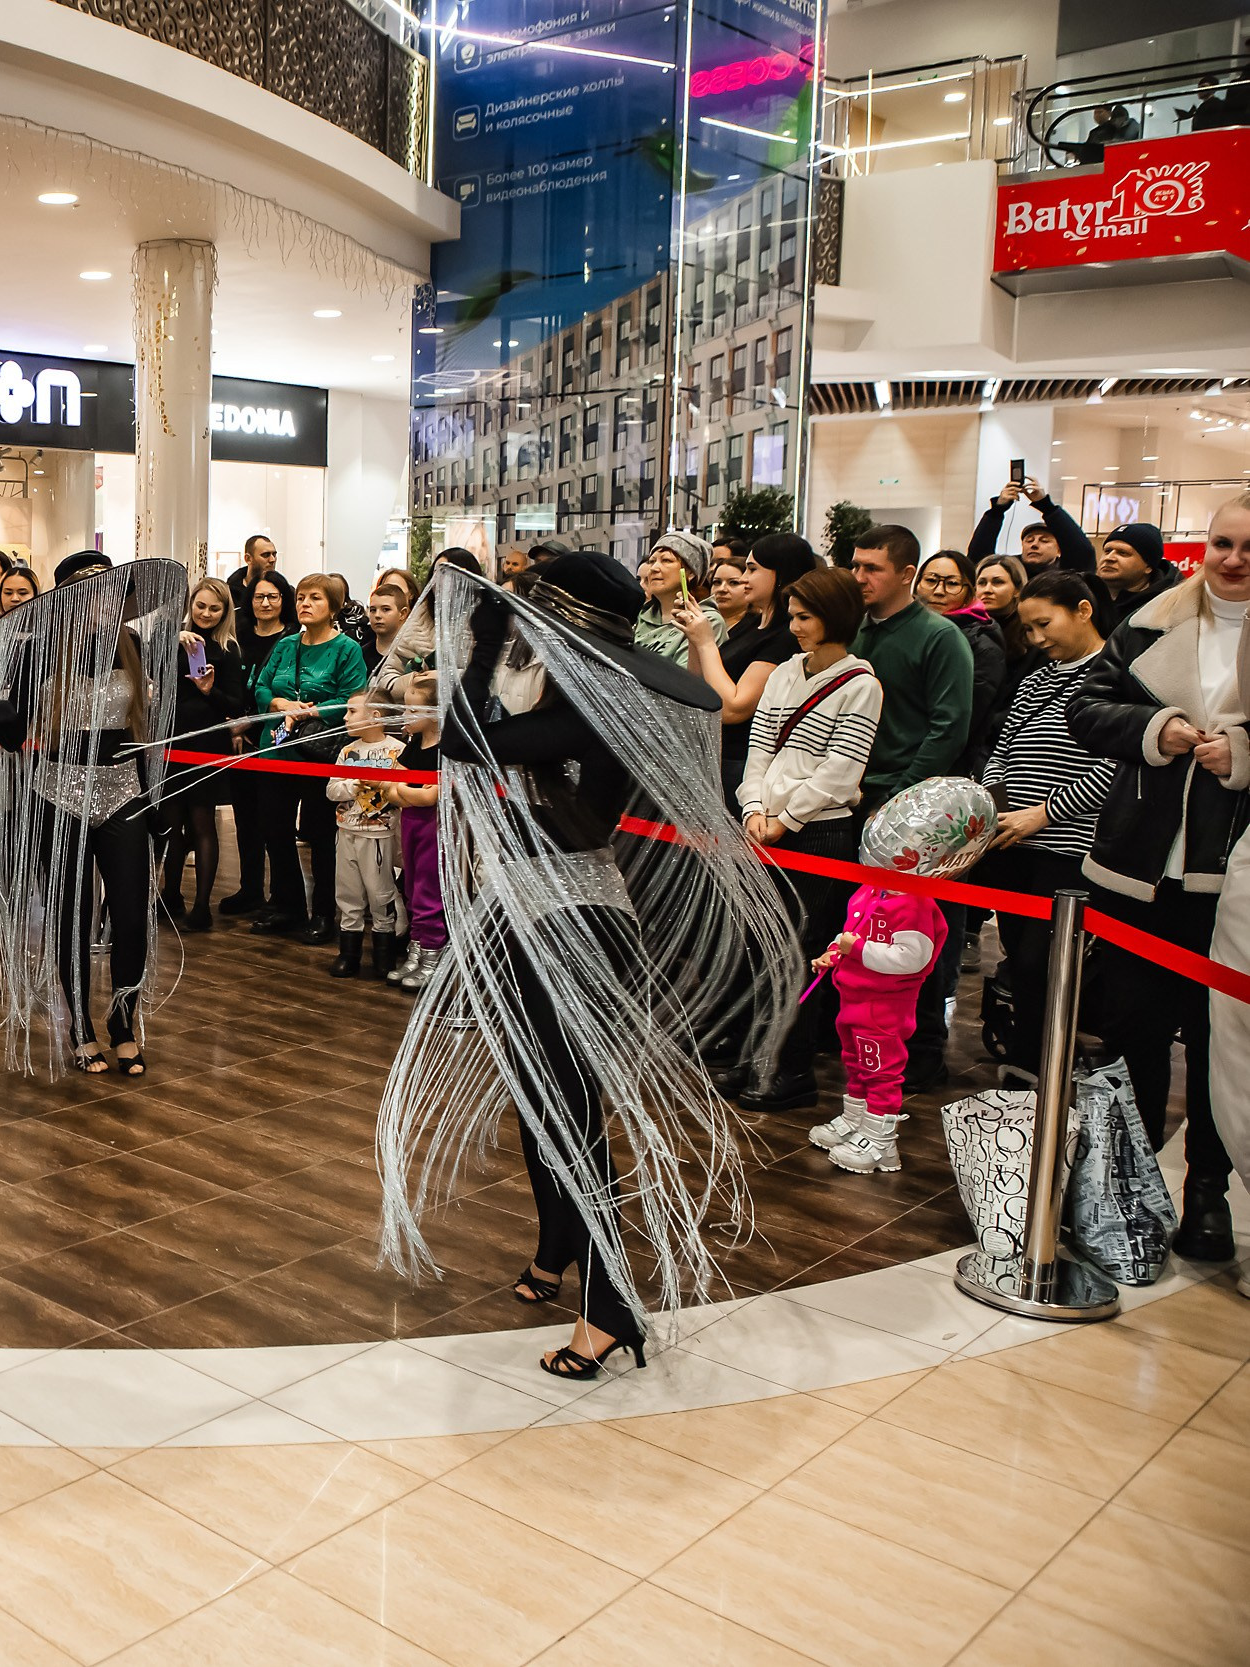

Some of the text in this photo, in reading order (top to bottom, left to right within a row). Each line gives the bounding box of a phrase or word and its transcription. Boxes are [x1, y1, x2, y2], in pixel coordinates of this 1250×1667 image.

[575, 22, 617, 41] замки
[581, 10, 590, 21] и
[484, 76, 625, 118] Дизайнерские холлы
[485, 105, 574, 133] и колясочные
[486, 155, 593, 186] Более 100 камер
[486, 170, 608, 203] видеонаблюдения
[1006, 198, 1114, 241] Batyr
[1093, 218, 1148, 239] mall
[211, 403, 297, 438] EDONIA
[856, 1035, 882, 1073] B
